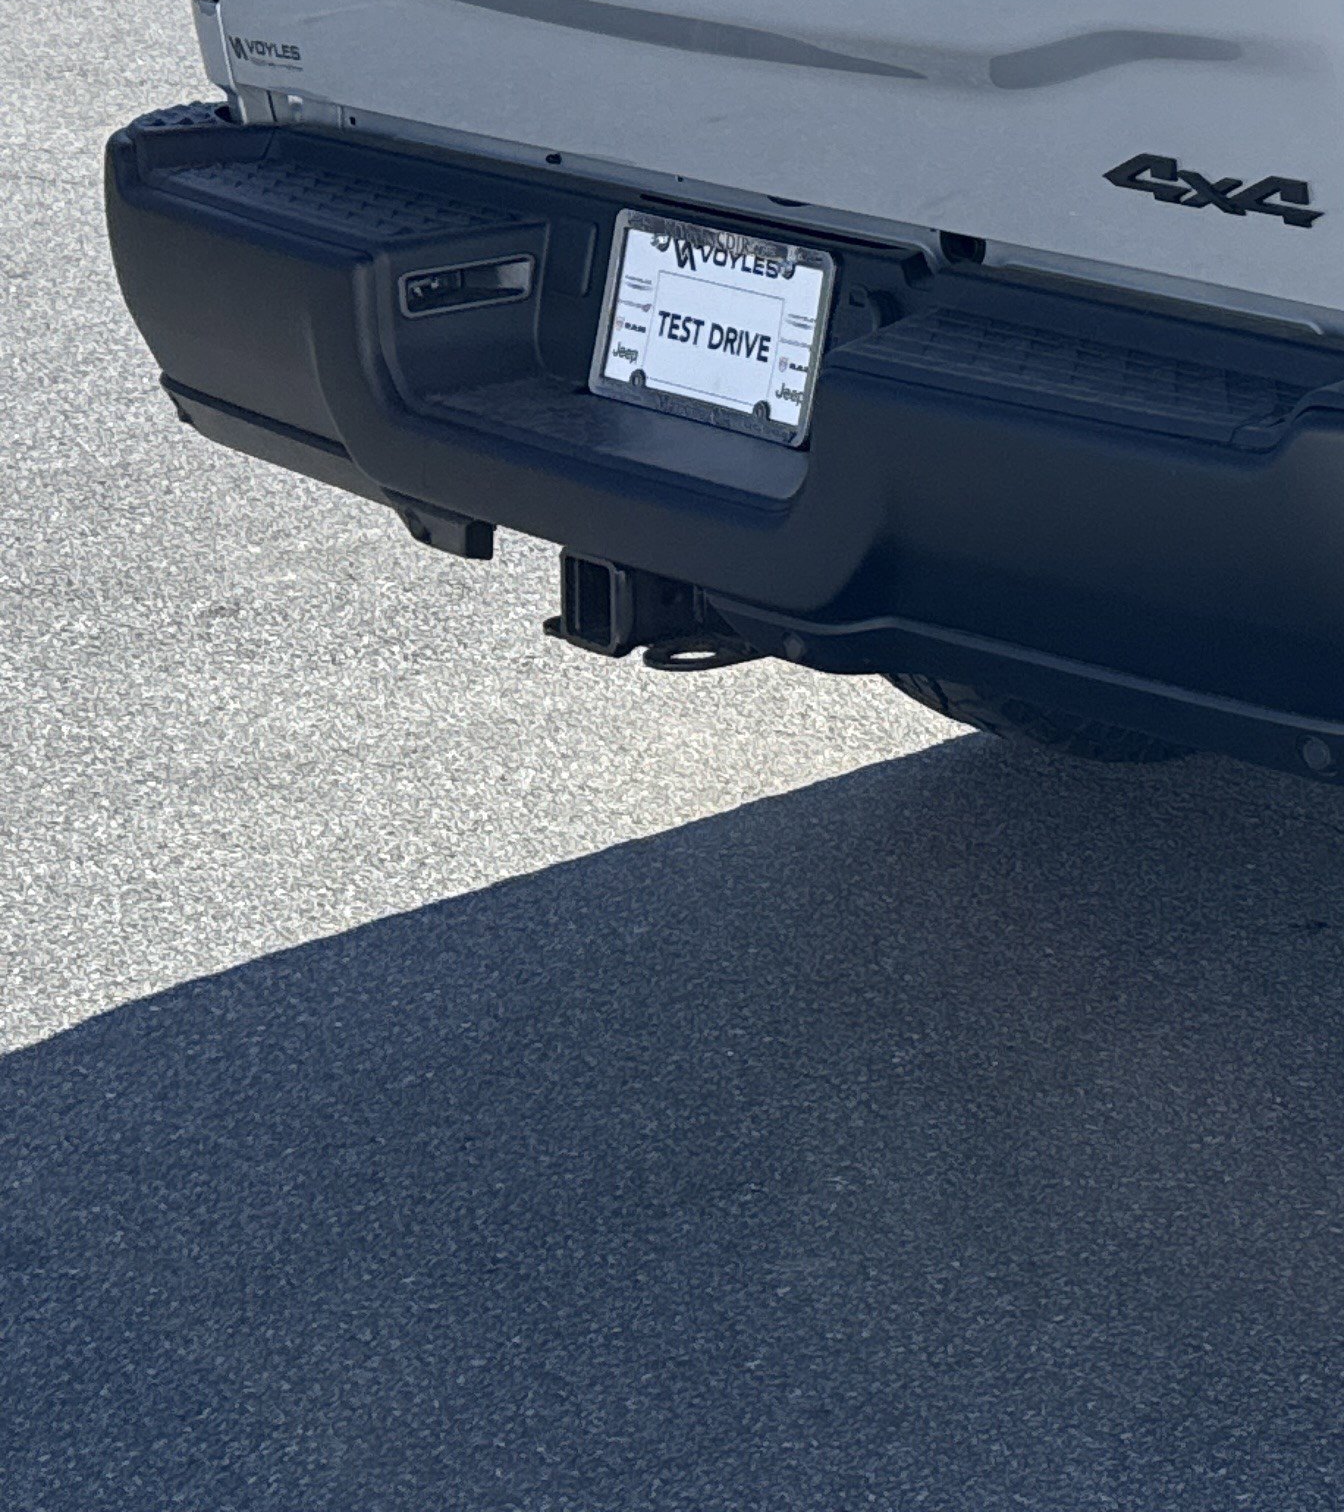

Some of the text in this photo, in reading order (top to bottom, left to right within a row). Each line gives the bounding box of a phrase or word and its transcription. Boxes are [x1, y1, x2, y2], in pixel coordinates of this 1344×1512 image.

[244, 39, 301, 61] VOYLES
[697, 244, 779, 279] VOYLES
[658, 310, 771, 363] TEST DRIVE
[613, 341, 639, 365] Jeep
